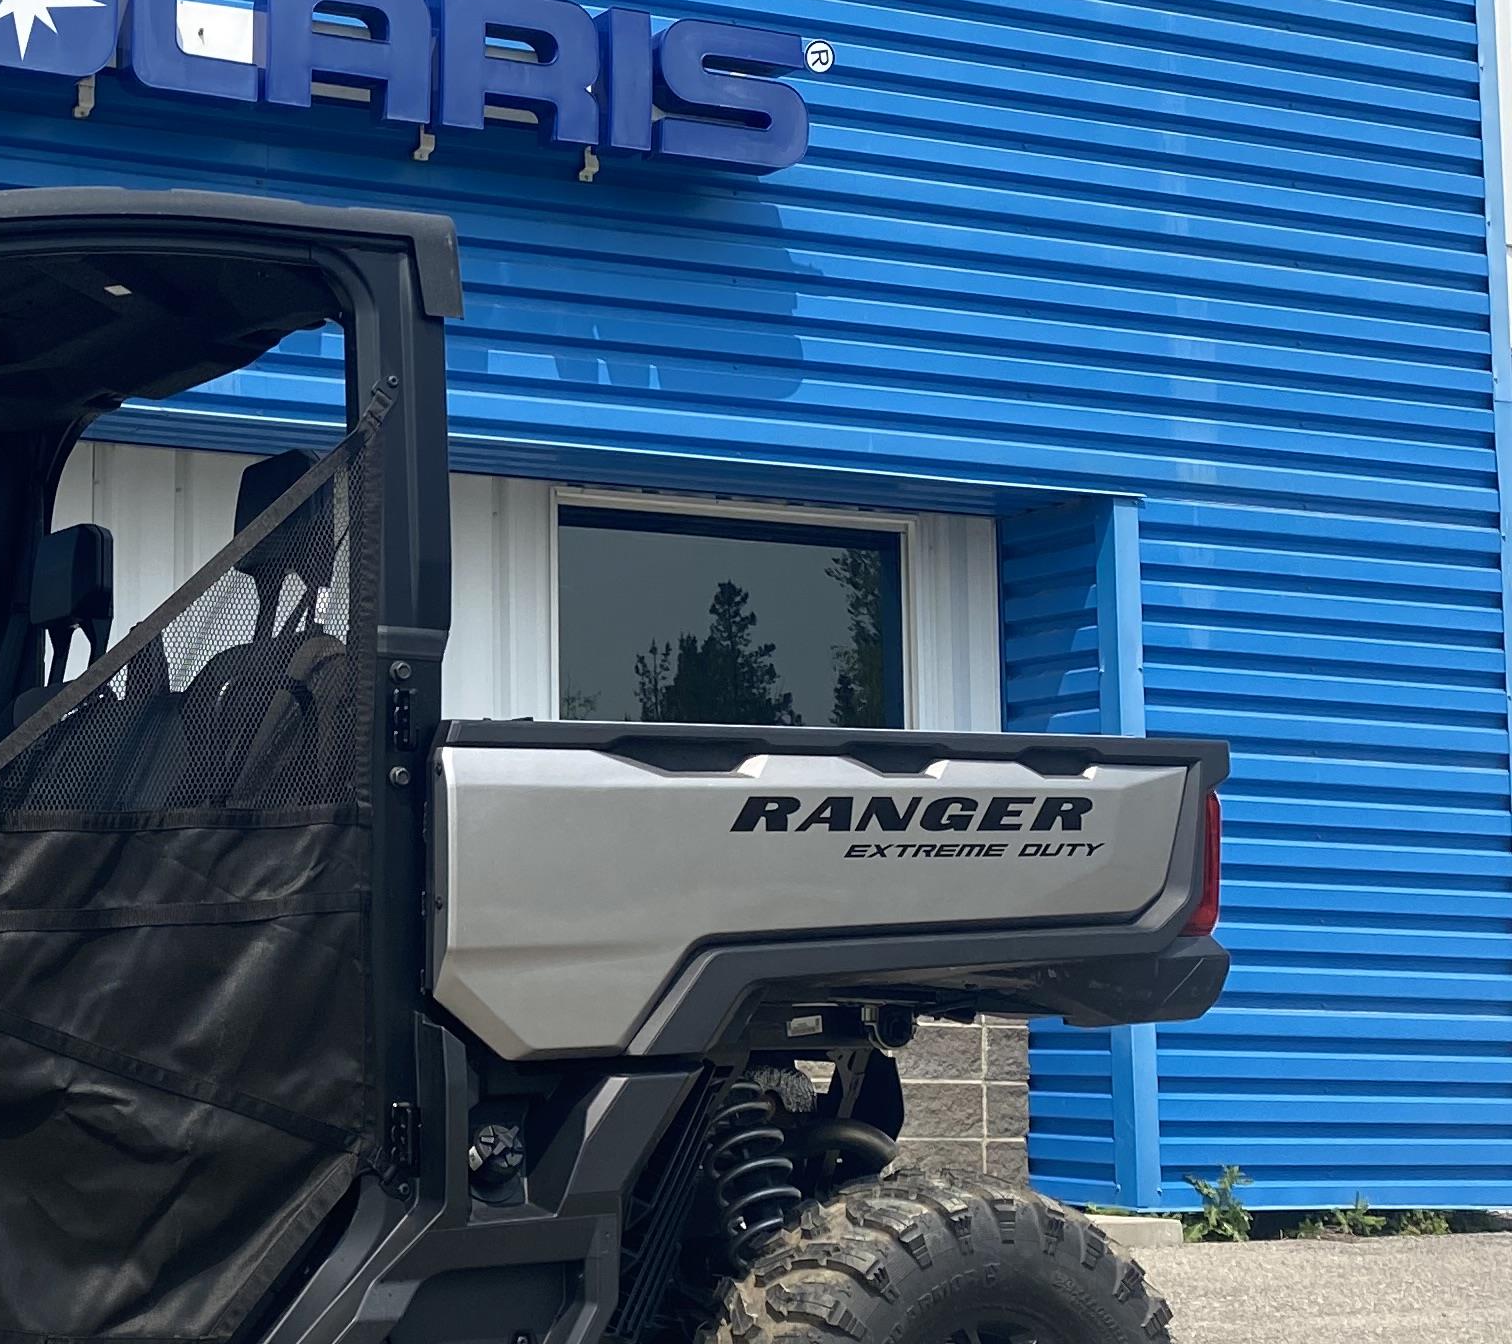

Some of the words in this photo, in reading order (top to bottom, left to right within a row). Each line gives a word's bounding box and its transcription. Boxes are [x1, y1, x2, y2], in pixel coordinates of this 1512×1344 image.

[730, 796, 1094, 832] RANGER
[844, 843, 1009, 859] EXTREME
[1018, 842, 1106, 858] DUTY
